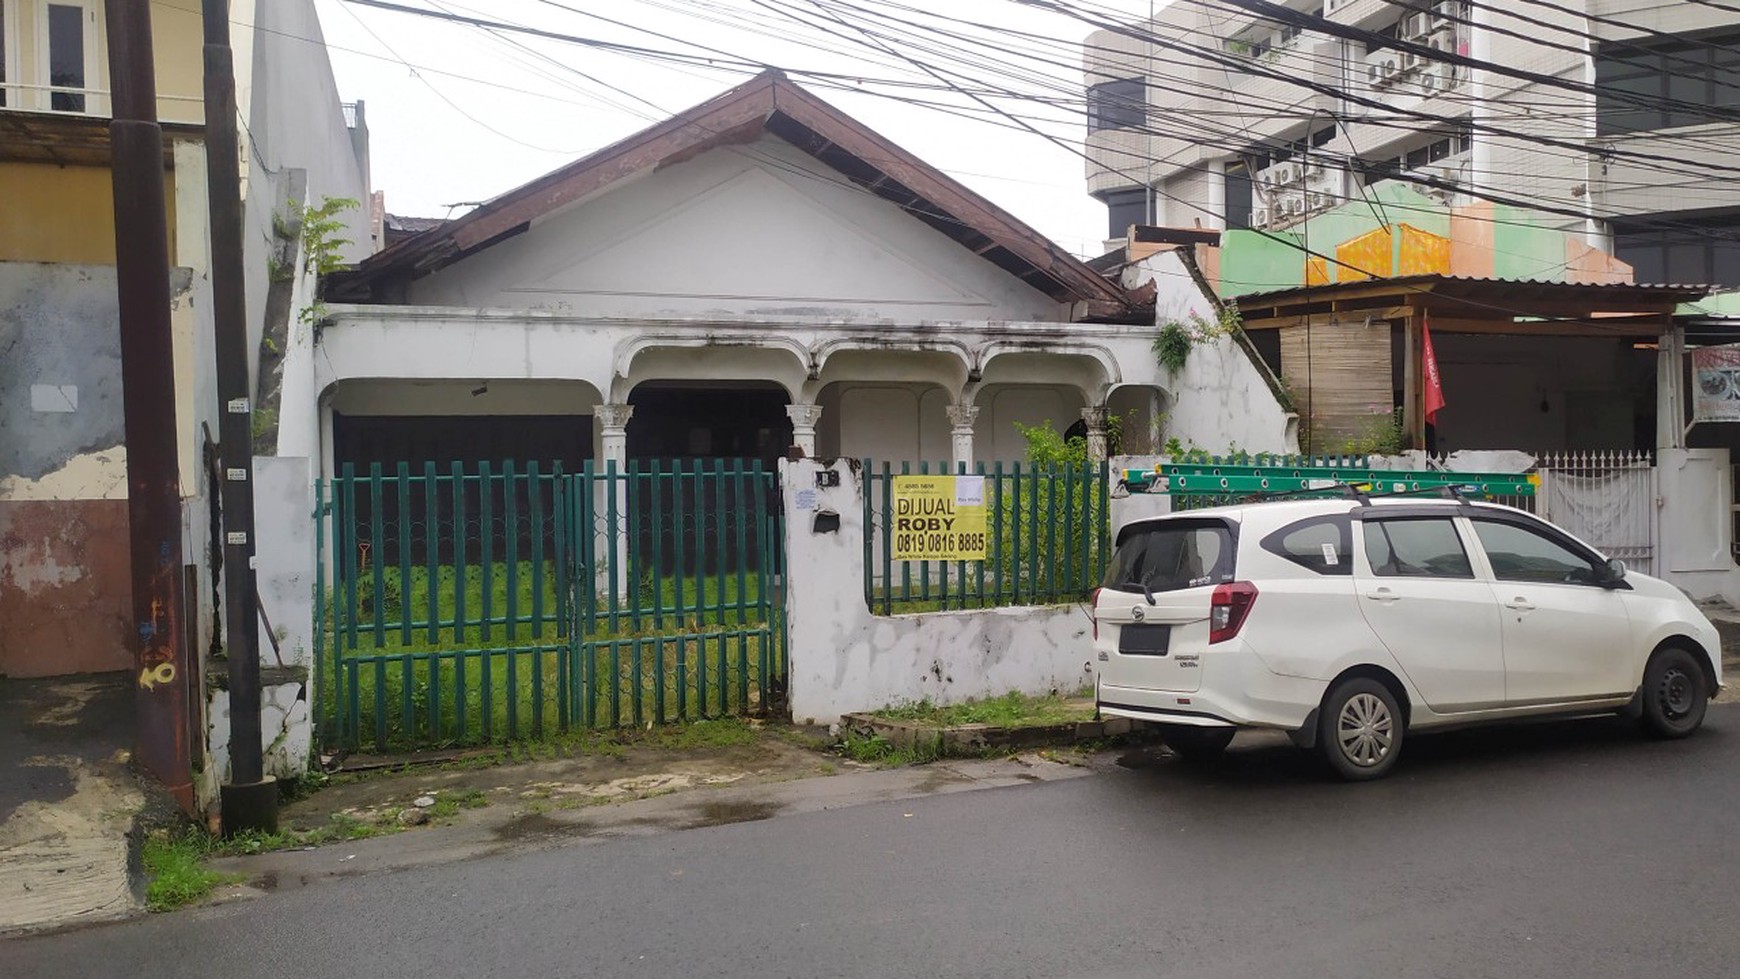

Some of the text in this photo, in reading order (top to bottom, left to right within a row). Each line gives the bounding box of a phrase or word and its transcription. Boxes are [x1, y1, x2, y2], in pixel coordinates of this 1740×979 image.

[898, 498, 955, 515] DIJUAL
[898, 518, 955, 531] ROBY
[898, 532, 984, 552] 0819 0816 8885
